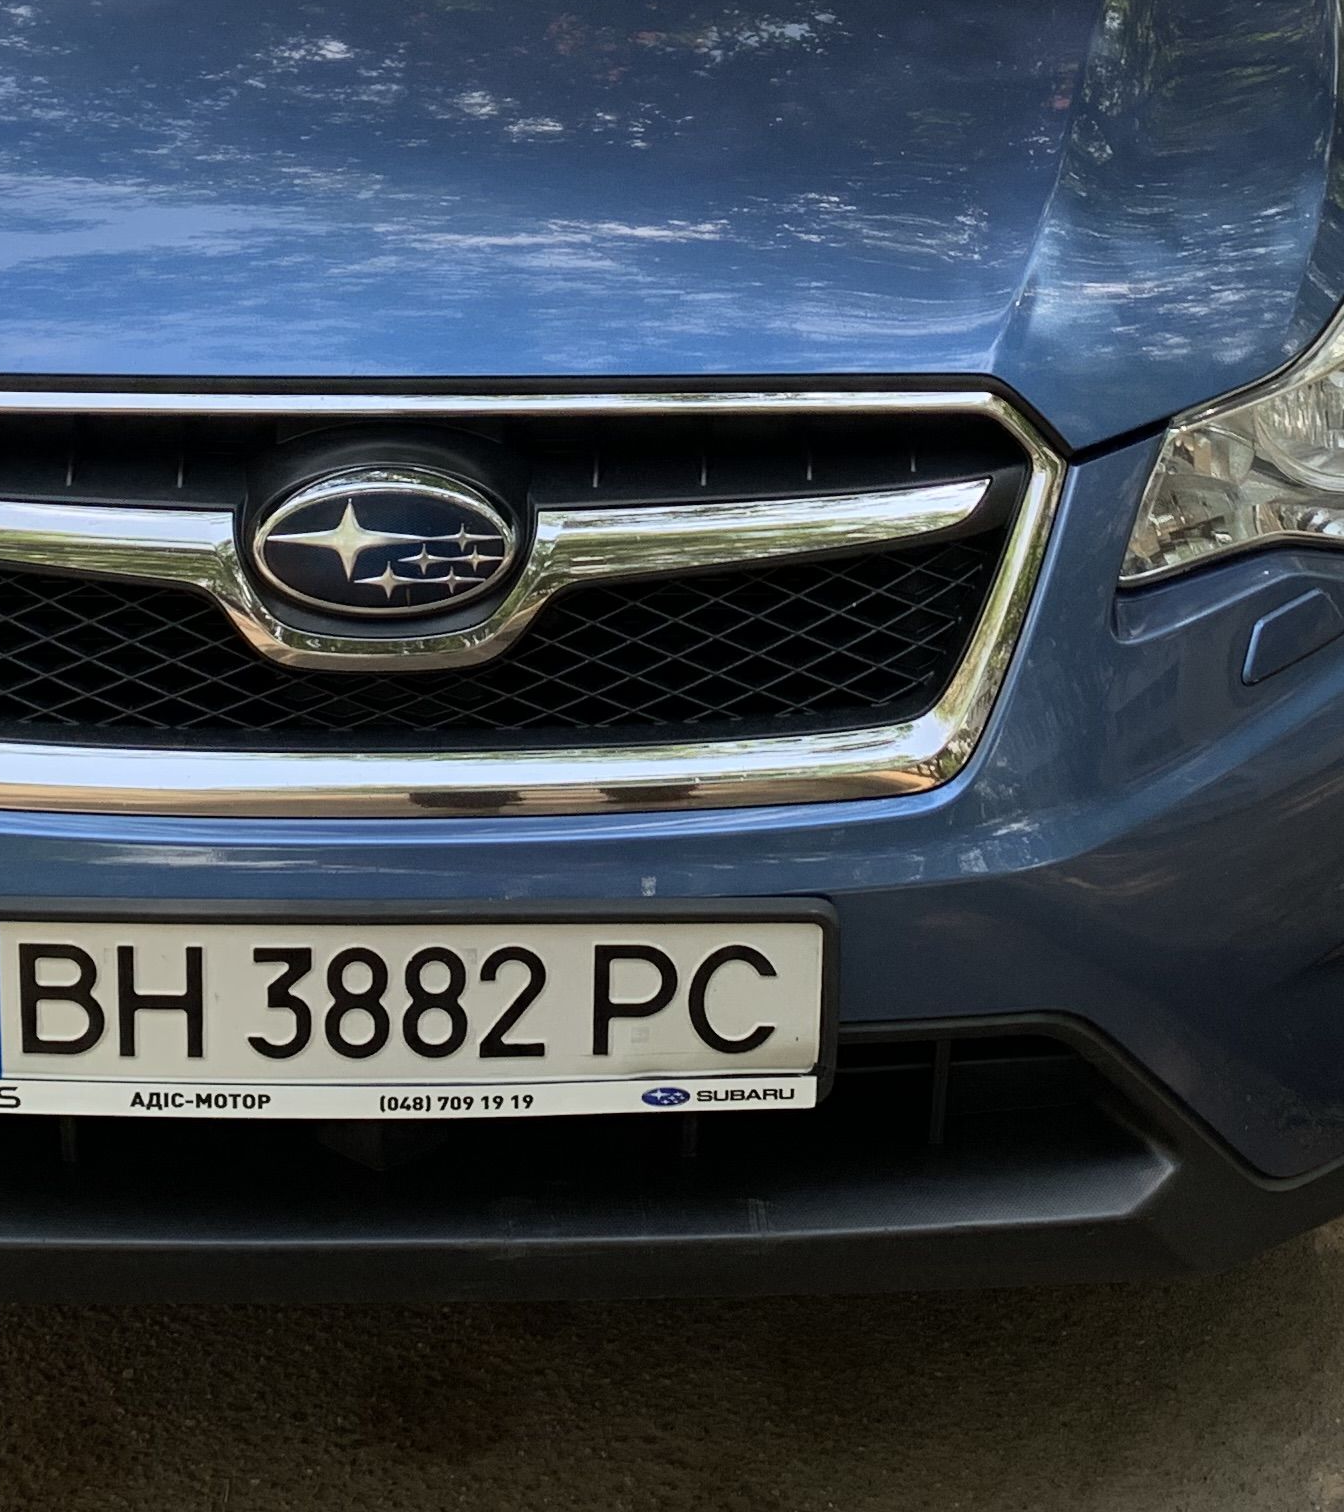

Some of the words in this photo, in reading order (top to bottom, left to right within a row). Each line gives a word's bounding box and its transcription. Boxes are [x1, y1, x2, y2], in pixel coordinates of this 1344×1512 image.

[247, 946, 546, 1059] 3882
[130, 1091, 272, 1110] АДІС-МОТОР
[379, 1095, 431, 1112] (048)
[437, 1095, 474, 1111] 709
[481, 1094, 504, 1110] 19
[511, 1094, 534, 1110] 19
[696, 1088, 795, 1102] SUBARU
